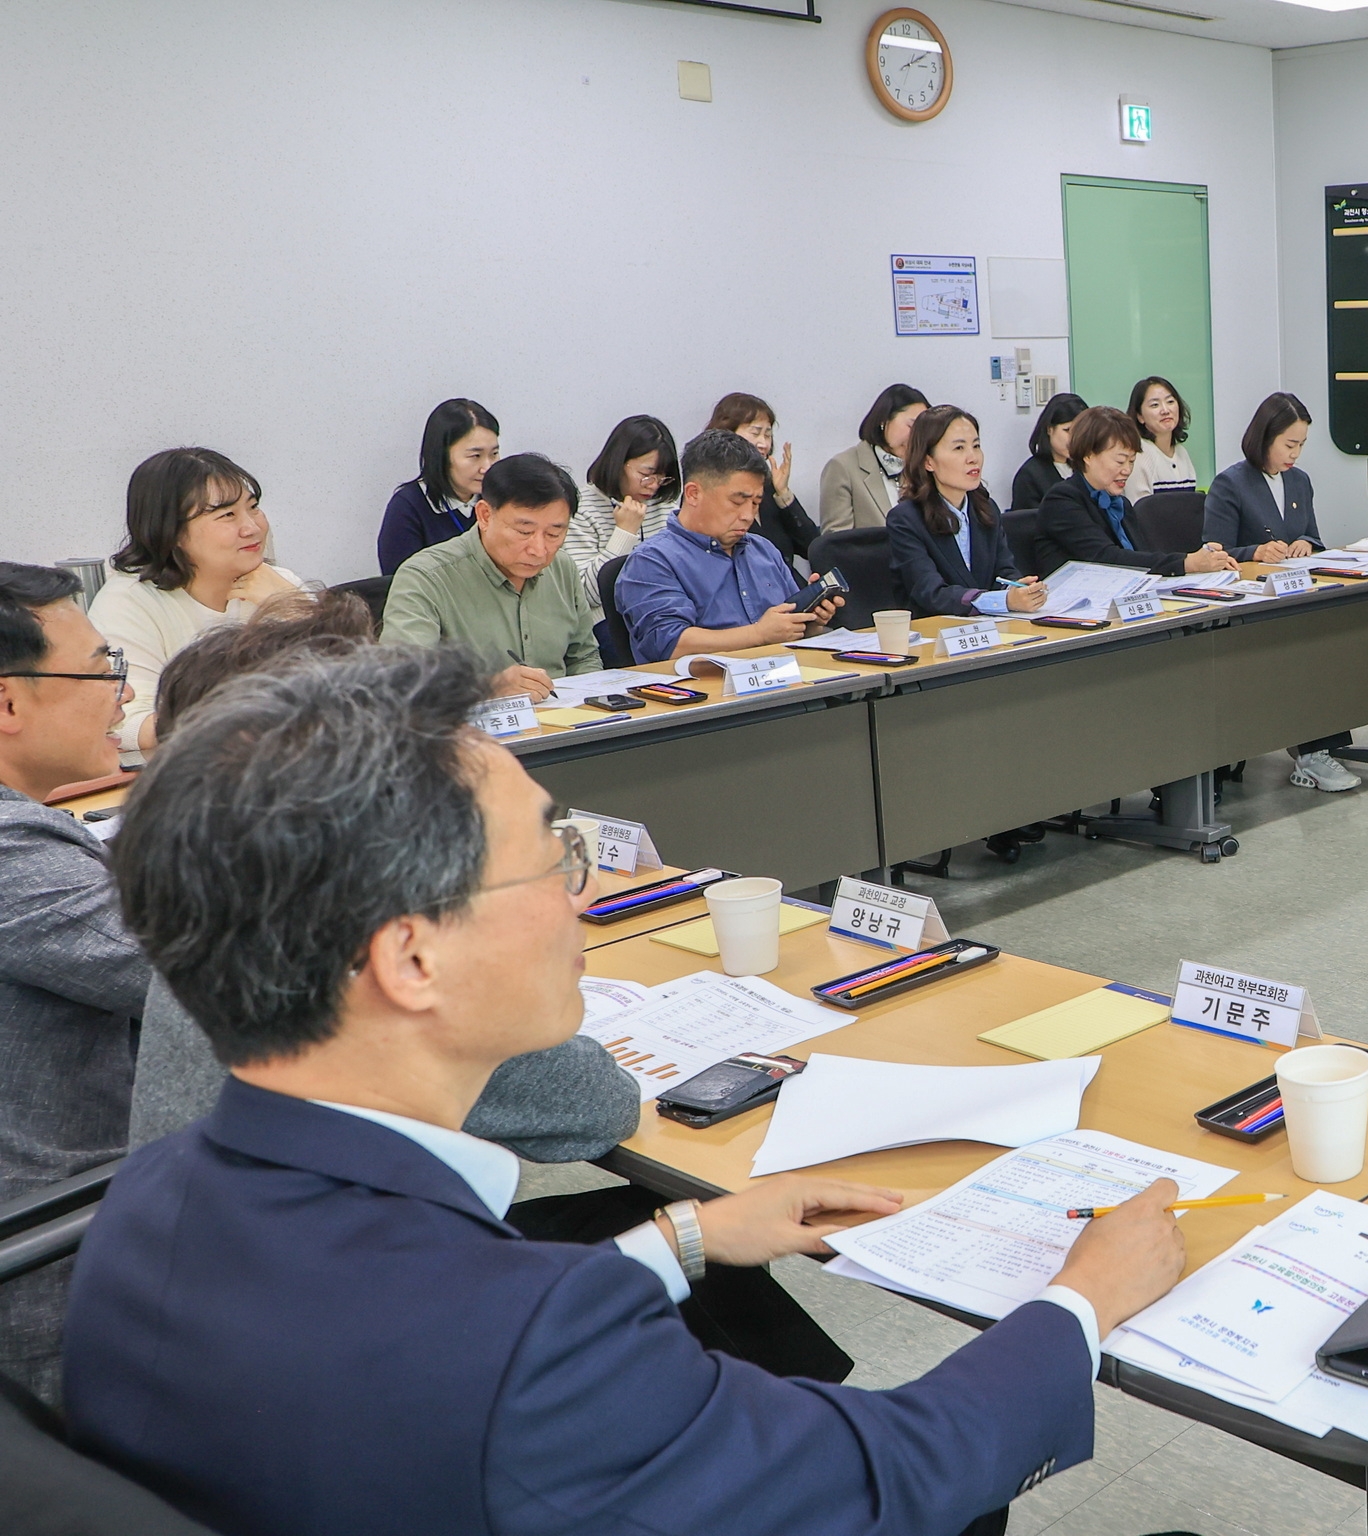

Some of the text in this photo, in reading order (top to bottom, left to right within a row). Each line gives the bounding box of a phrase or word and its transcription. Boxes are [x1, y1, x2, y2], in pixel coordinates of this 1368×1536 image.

[958, 634, 990, 650] 정민석
[858, 887, 907, 909] 과천외고 교장
[851, 907, 902, 938] 양낭규
[1194, 969, 1289, 1003] 과천여고 학부모회장
[1201, 996, 1271, 1032] 기문주
[1240, 1251, 1268, 1265] 과천시
[1268, 1261, 1328, 1295] 교육발전협의회
